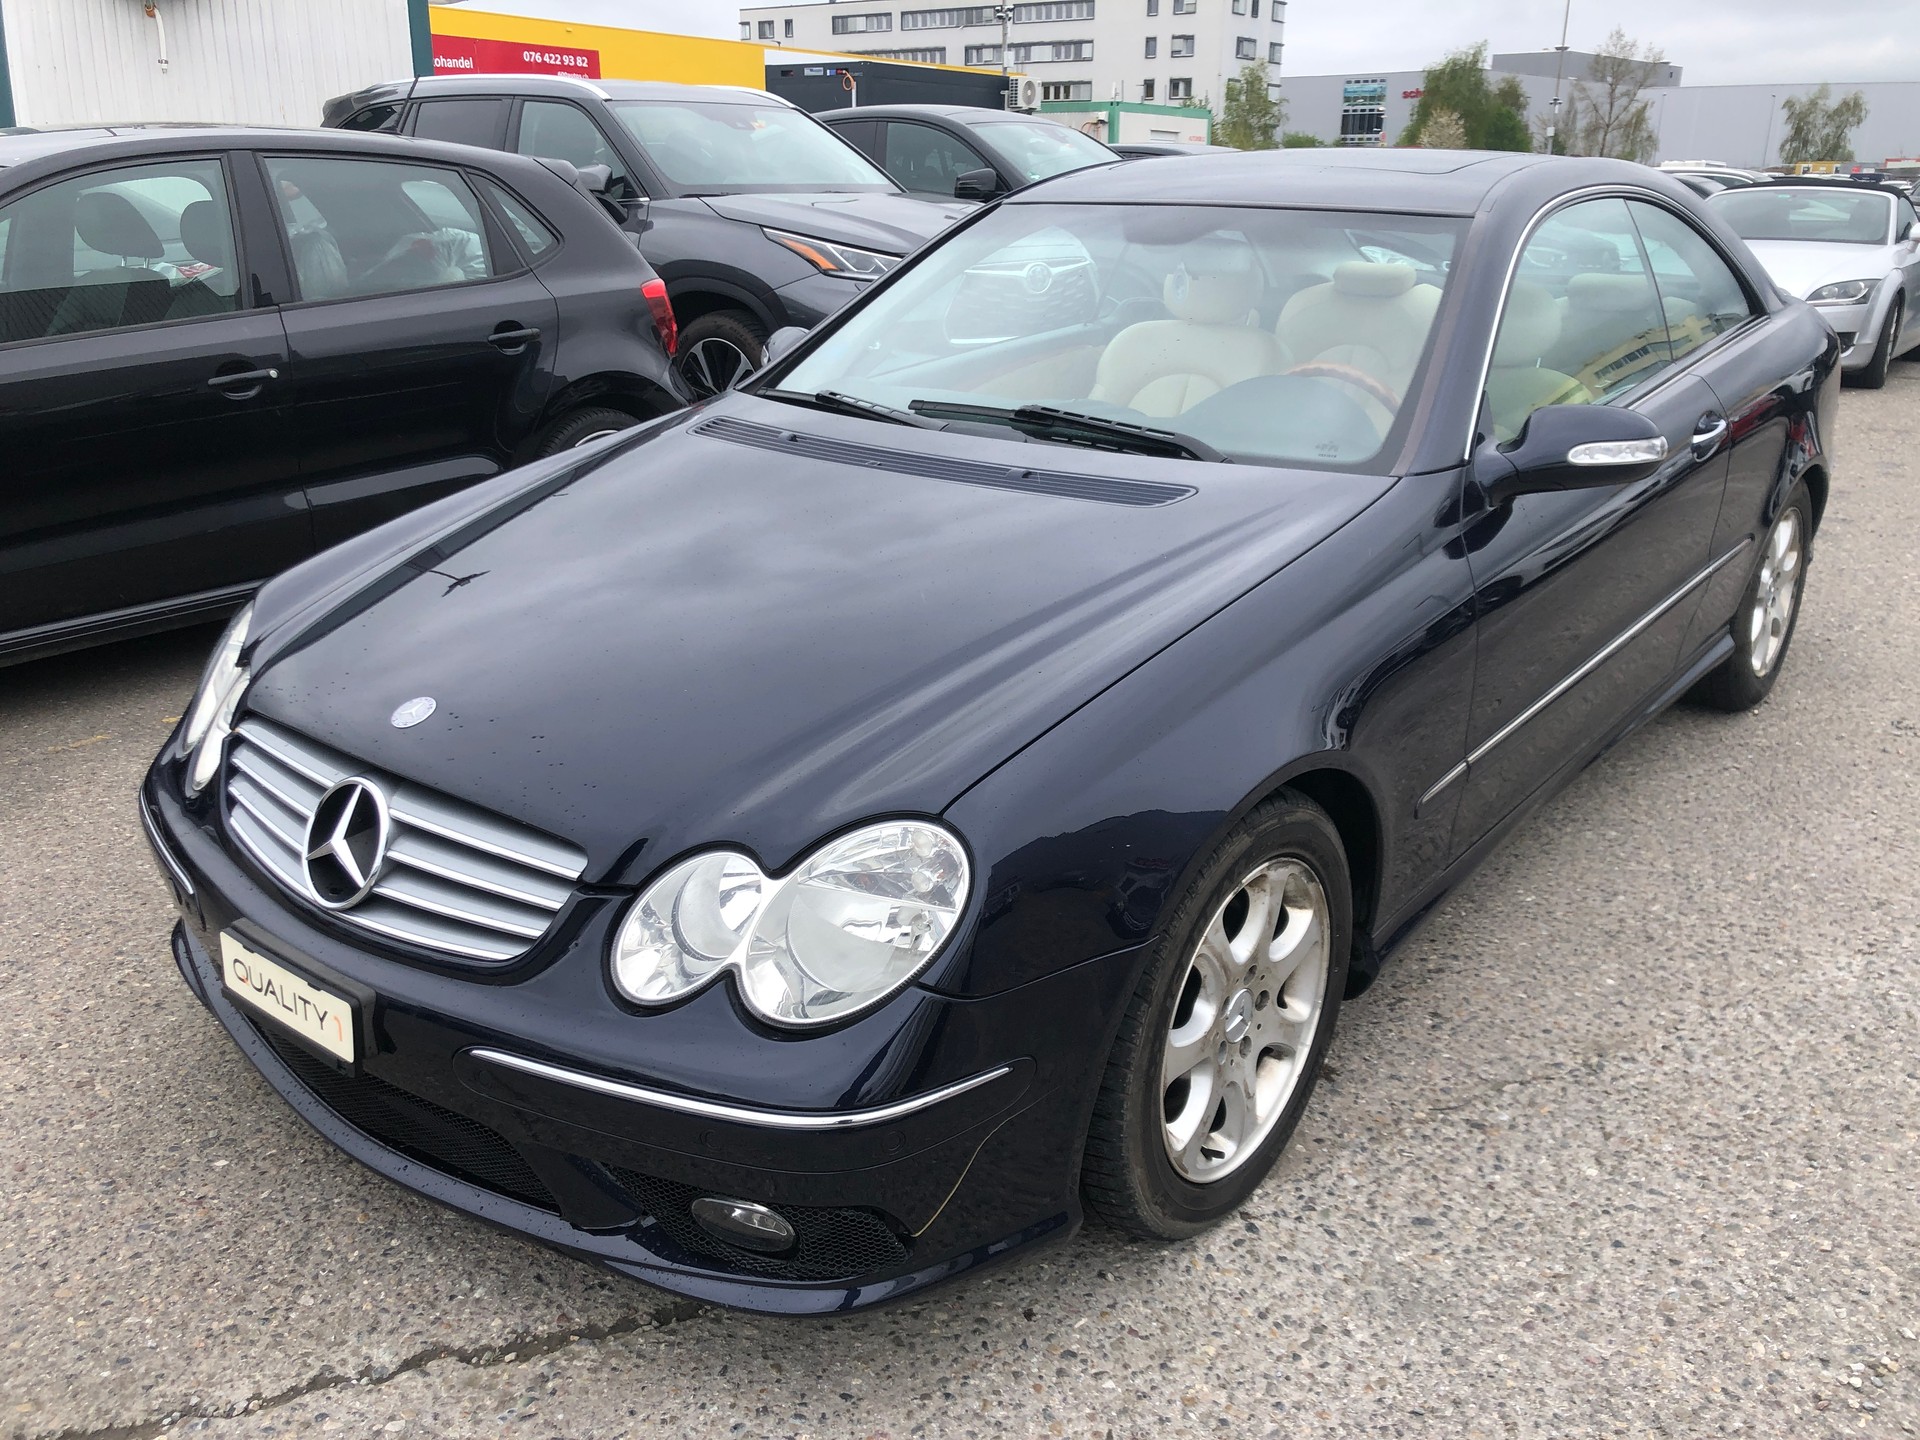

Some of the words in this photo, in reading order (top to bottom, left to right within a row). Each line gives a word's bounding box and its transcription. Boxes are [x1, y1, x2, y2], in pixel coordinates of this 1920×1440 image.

[433, 55, 474, 69] ohandel
[523, 51, 542, 63] 076
[543, 53, 562, 65] 422
[562, 55, 575, 66] 93
[576, 56, 589, 68] 82
